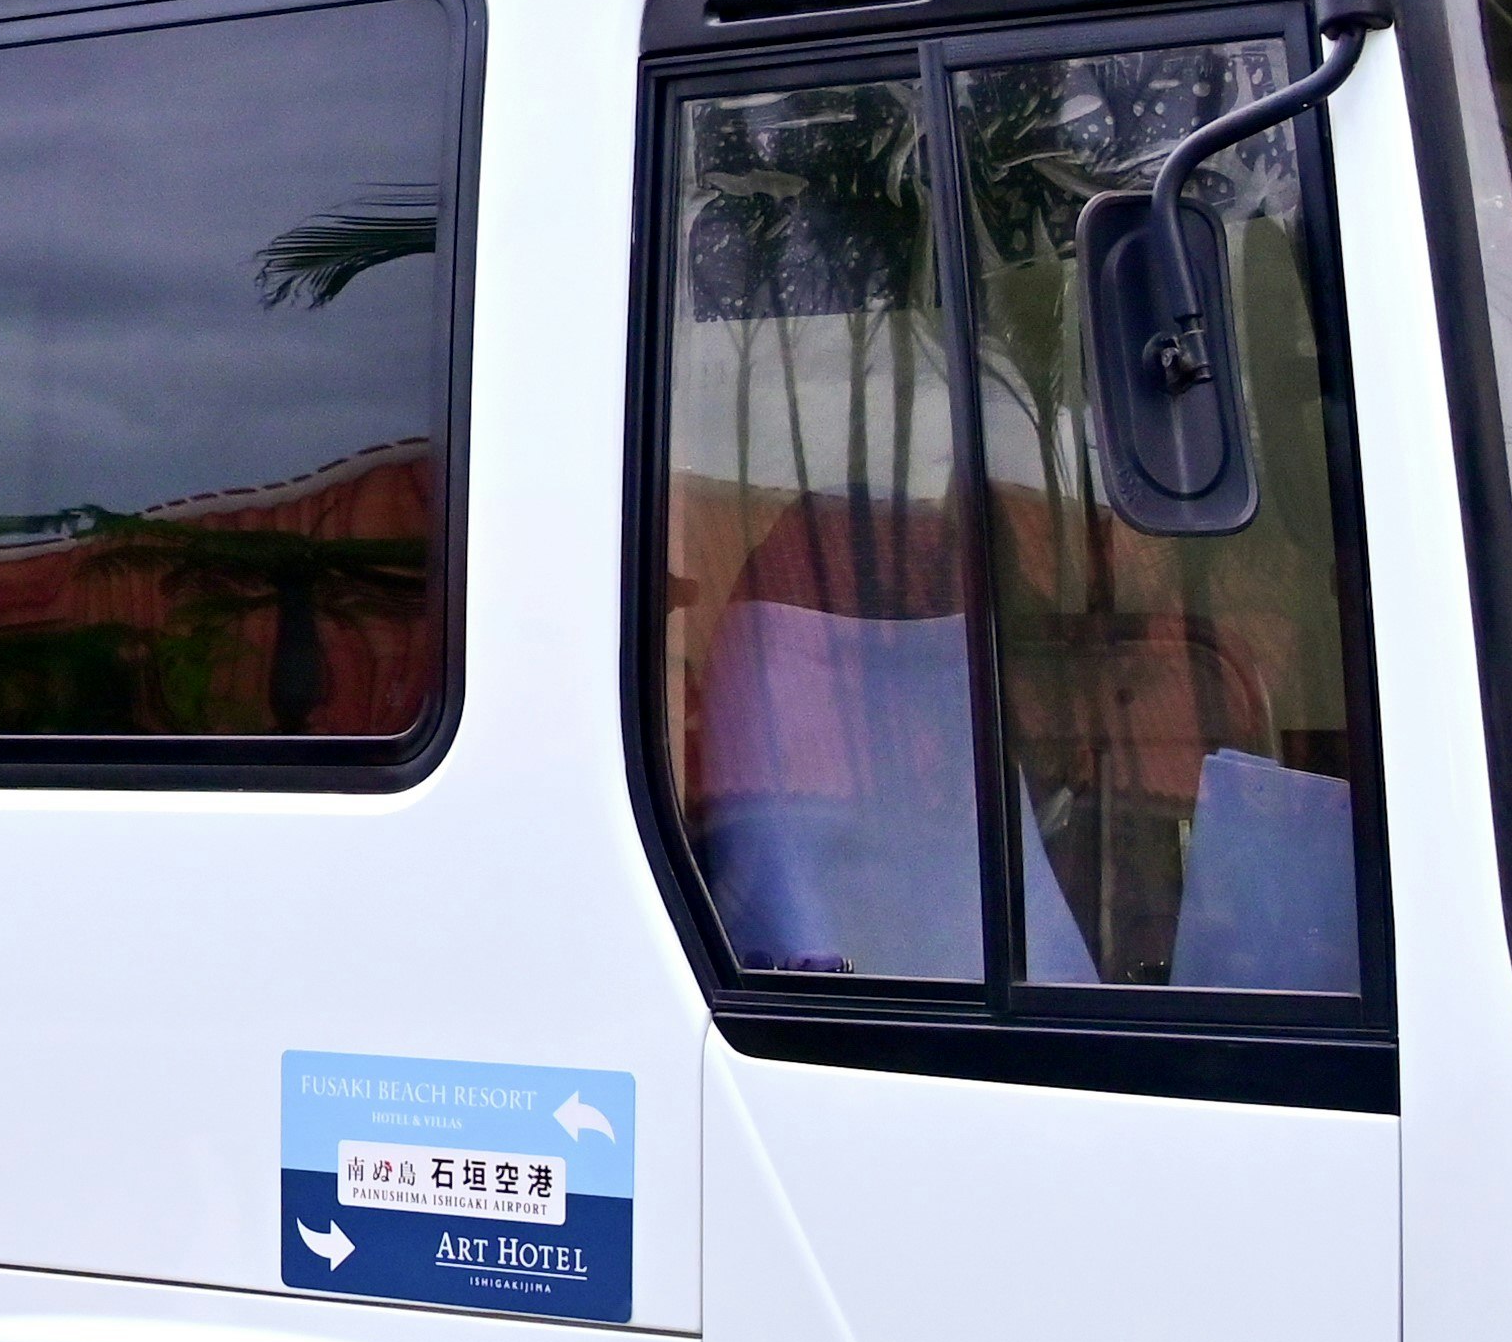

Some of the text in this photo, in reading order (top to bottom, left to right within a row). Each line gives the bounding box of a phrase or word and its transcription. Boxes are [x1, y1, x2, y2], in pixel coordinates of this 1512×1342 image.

[301, 1074, 539, 1111] FUSAKI BEACH RESORT
[372, 1111, 463, 1130] HOTEL & VILLAS
[431, 1158, 553, 1198] 石垣空港
[352, 1187, 548, 1216] PAINUSHIMA ISHIGAKI AIRPORT
[436, 1232, 588, 1273] ART HOTEL
[469, 1276, 552, 1294] ISHIGAKIJIMA
